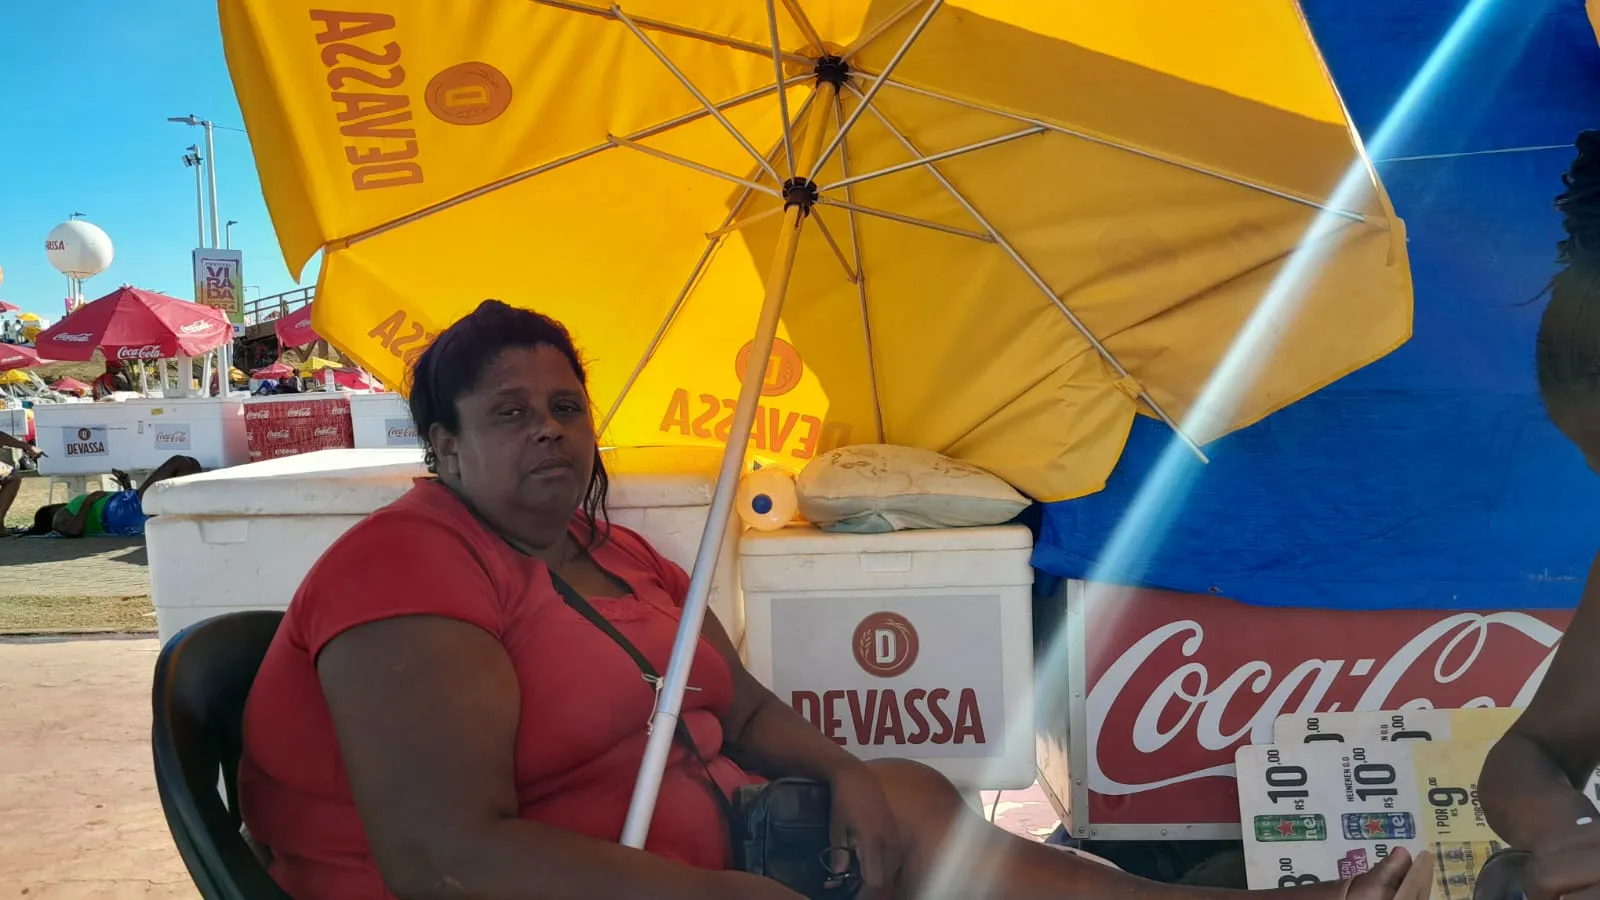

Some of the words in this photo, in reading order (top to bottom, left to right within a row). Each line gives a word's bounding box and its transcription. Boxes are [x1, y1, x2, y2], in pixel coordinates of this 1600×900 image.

[206, 266, 230, 278] VI
[67, 442, 105, 455] DEVASSA
[875, 629, 896, 663] D
[792, 688, 986, 745] DEVASSA
[1343, 769, 1355, 802] HEINEKEN
[1294, 799, 1305, 810] R$
[1383, 797, 1394, 808] R$
[1434, 808, 1450, 827] POR
